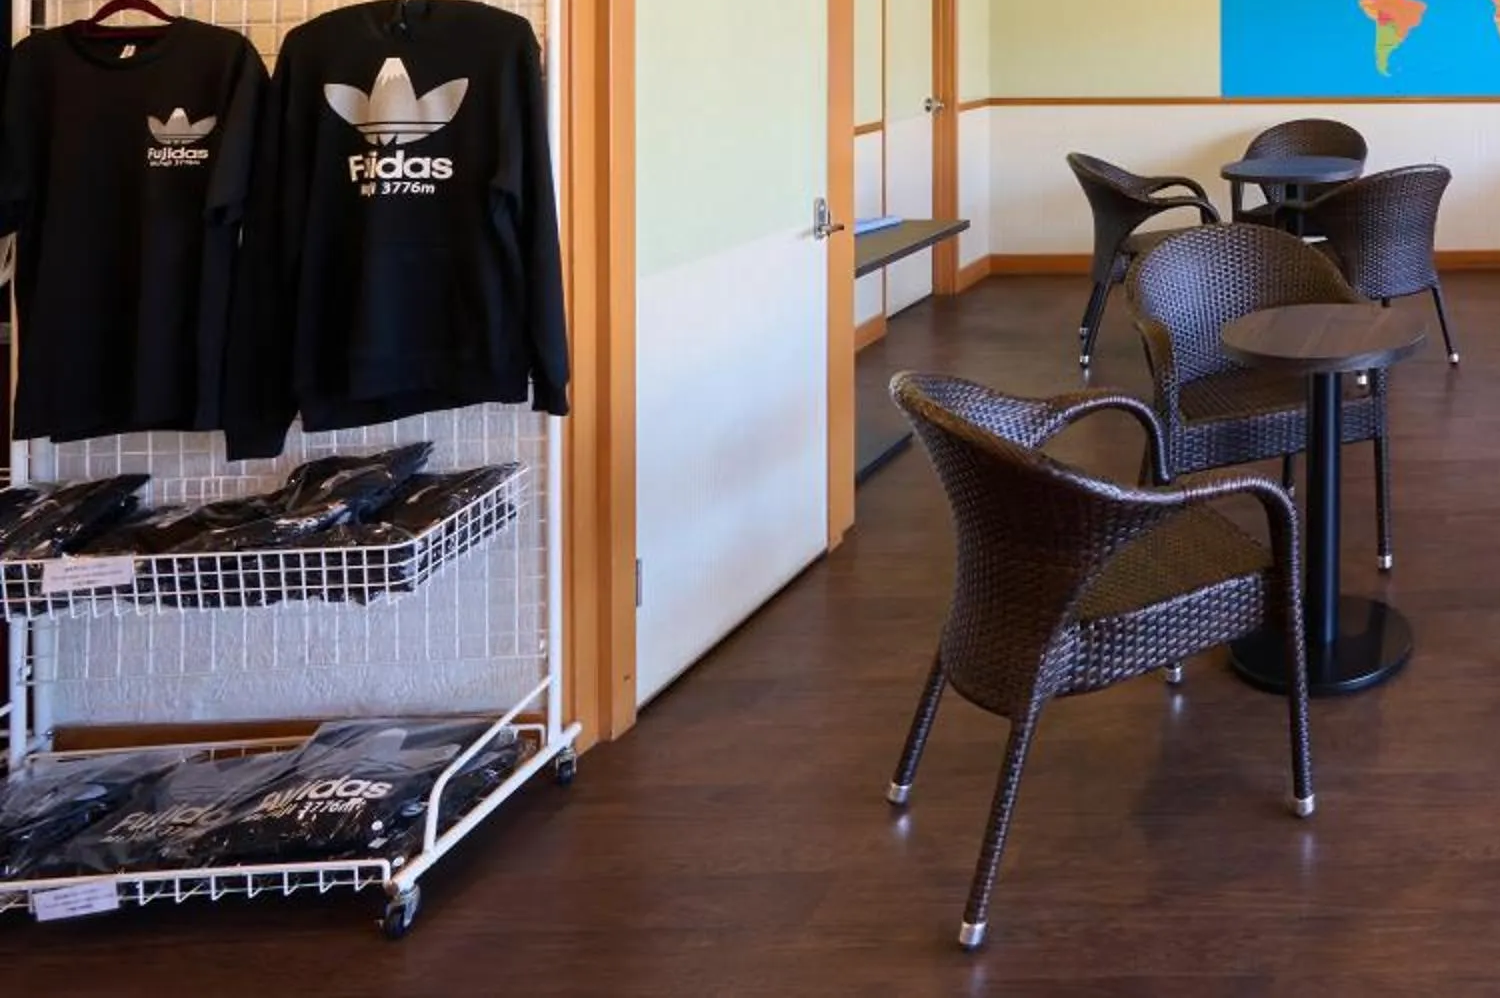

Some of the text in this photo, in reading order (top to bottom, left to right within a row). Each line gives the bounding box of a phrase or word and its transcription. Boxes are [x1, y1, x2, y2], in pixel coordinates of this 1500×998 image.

[147, 146, 209, 161] Fujidas
[348, 149, 453, 182] Fidas
[381, 181, 436, 195] 3776m
